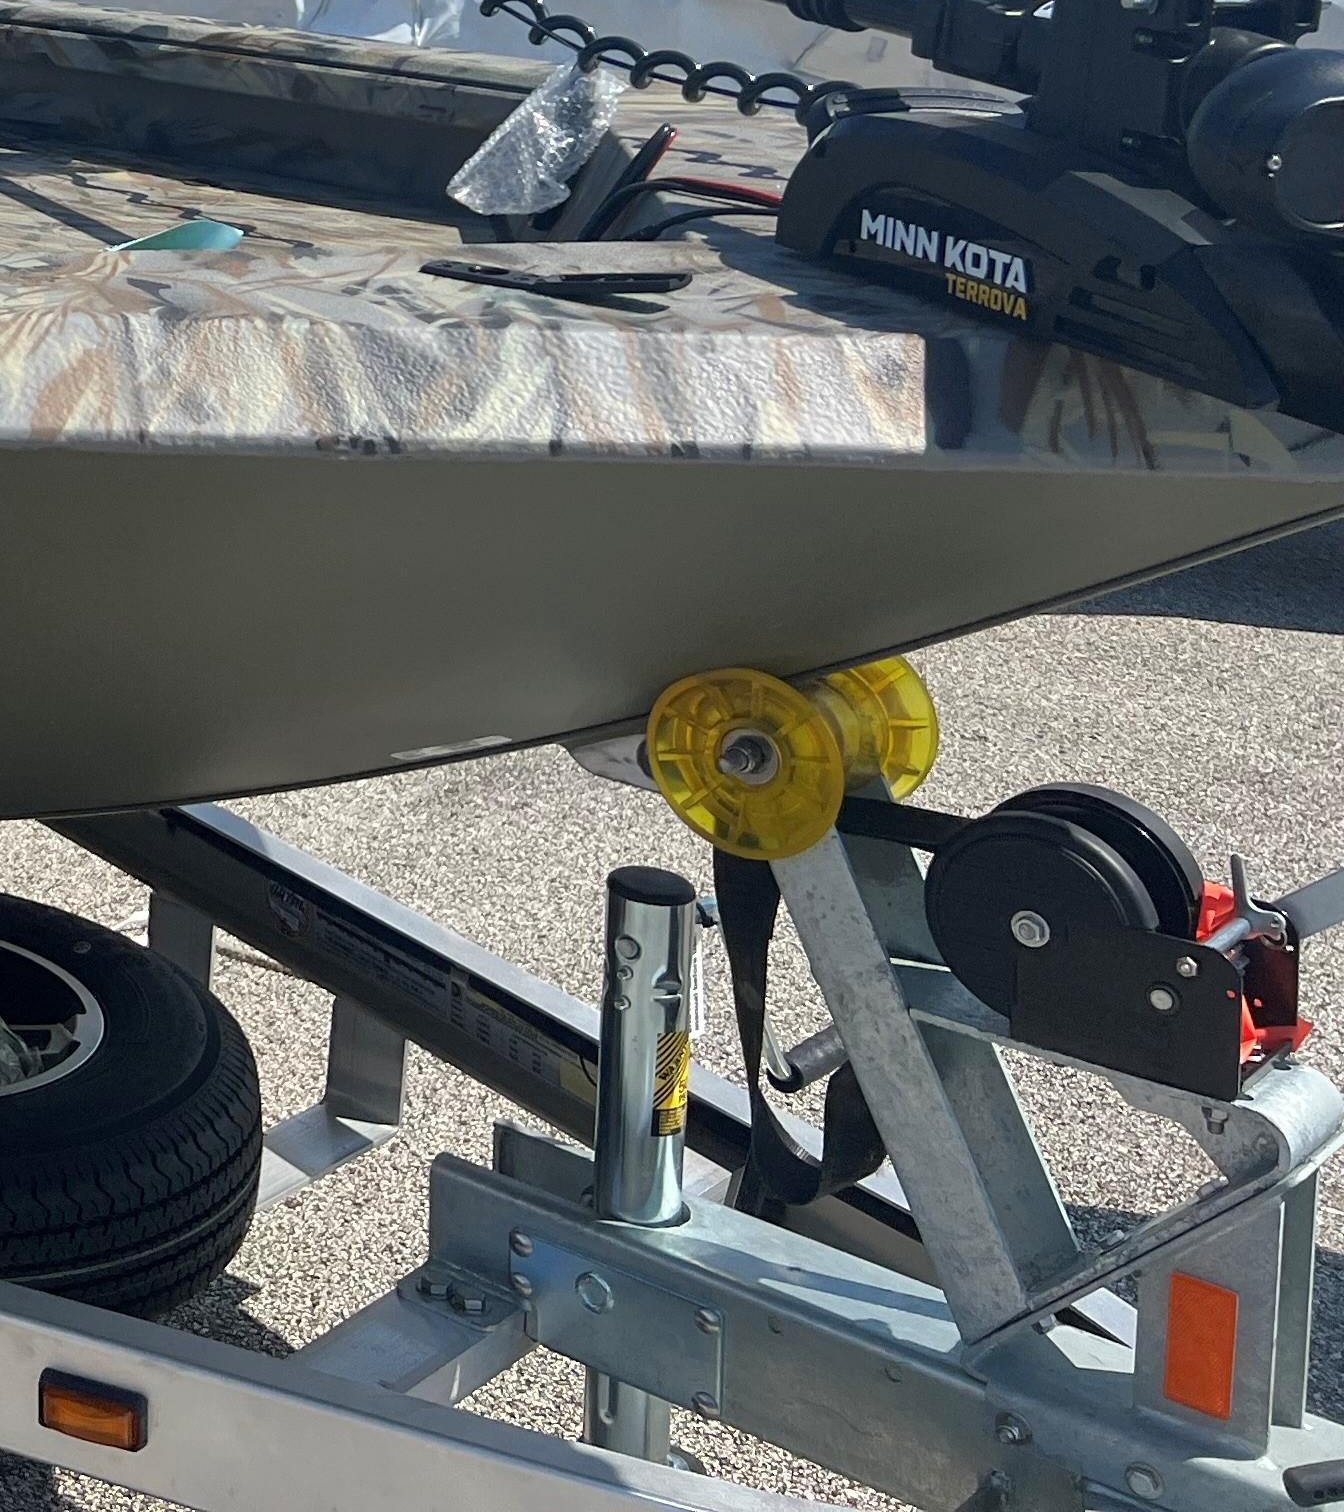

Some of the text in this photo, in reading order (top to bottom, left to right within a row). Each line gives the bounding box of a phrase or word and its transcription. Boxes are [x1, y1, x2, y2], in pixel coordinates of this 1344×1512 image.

[860, 208, 1028, 294] MINN KOTA
[944, 273, 1028, 321] TERROVA
